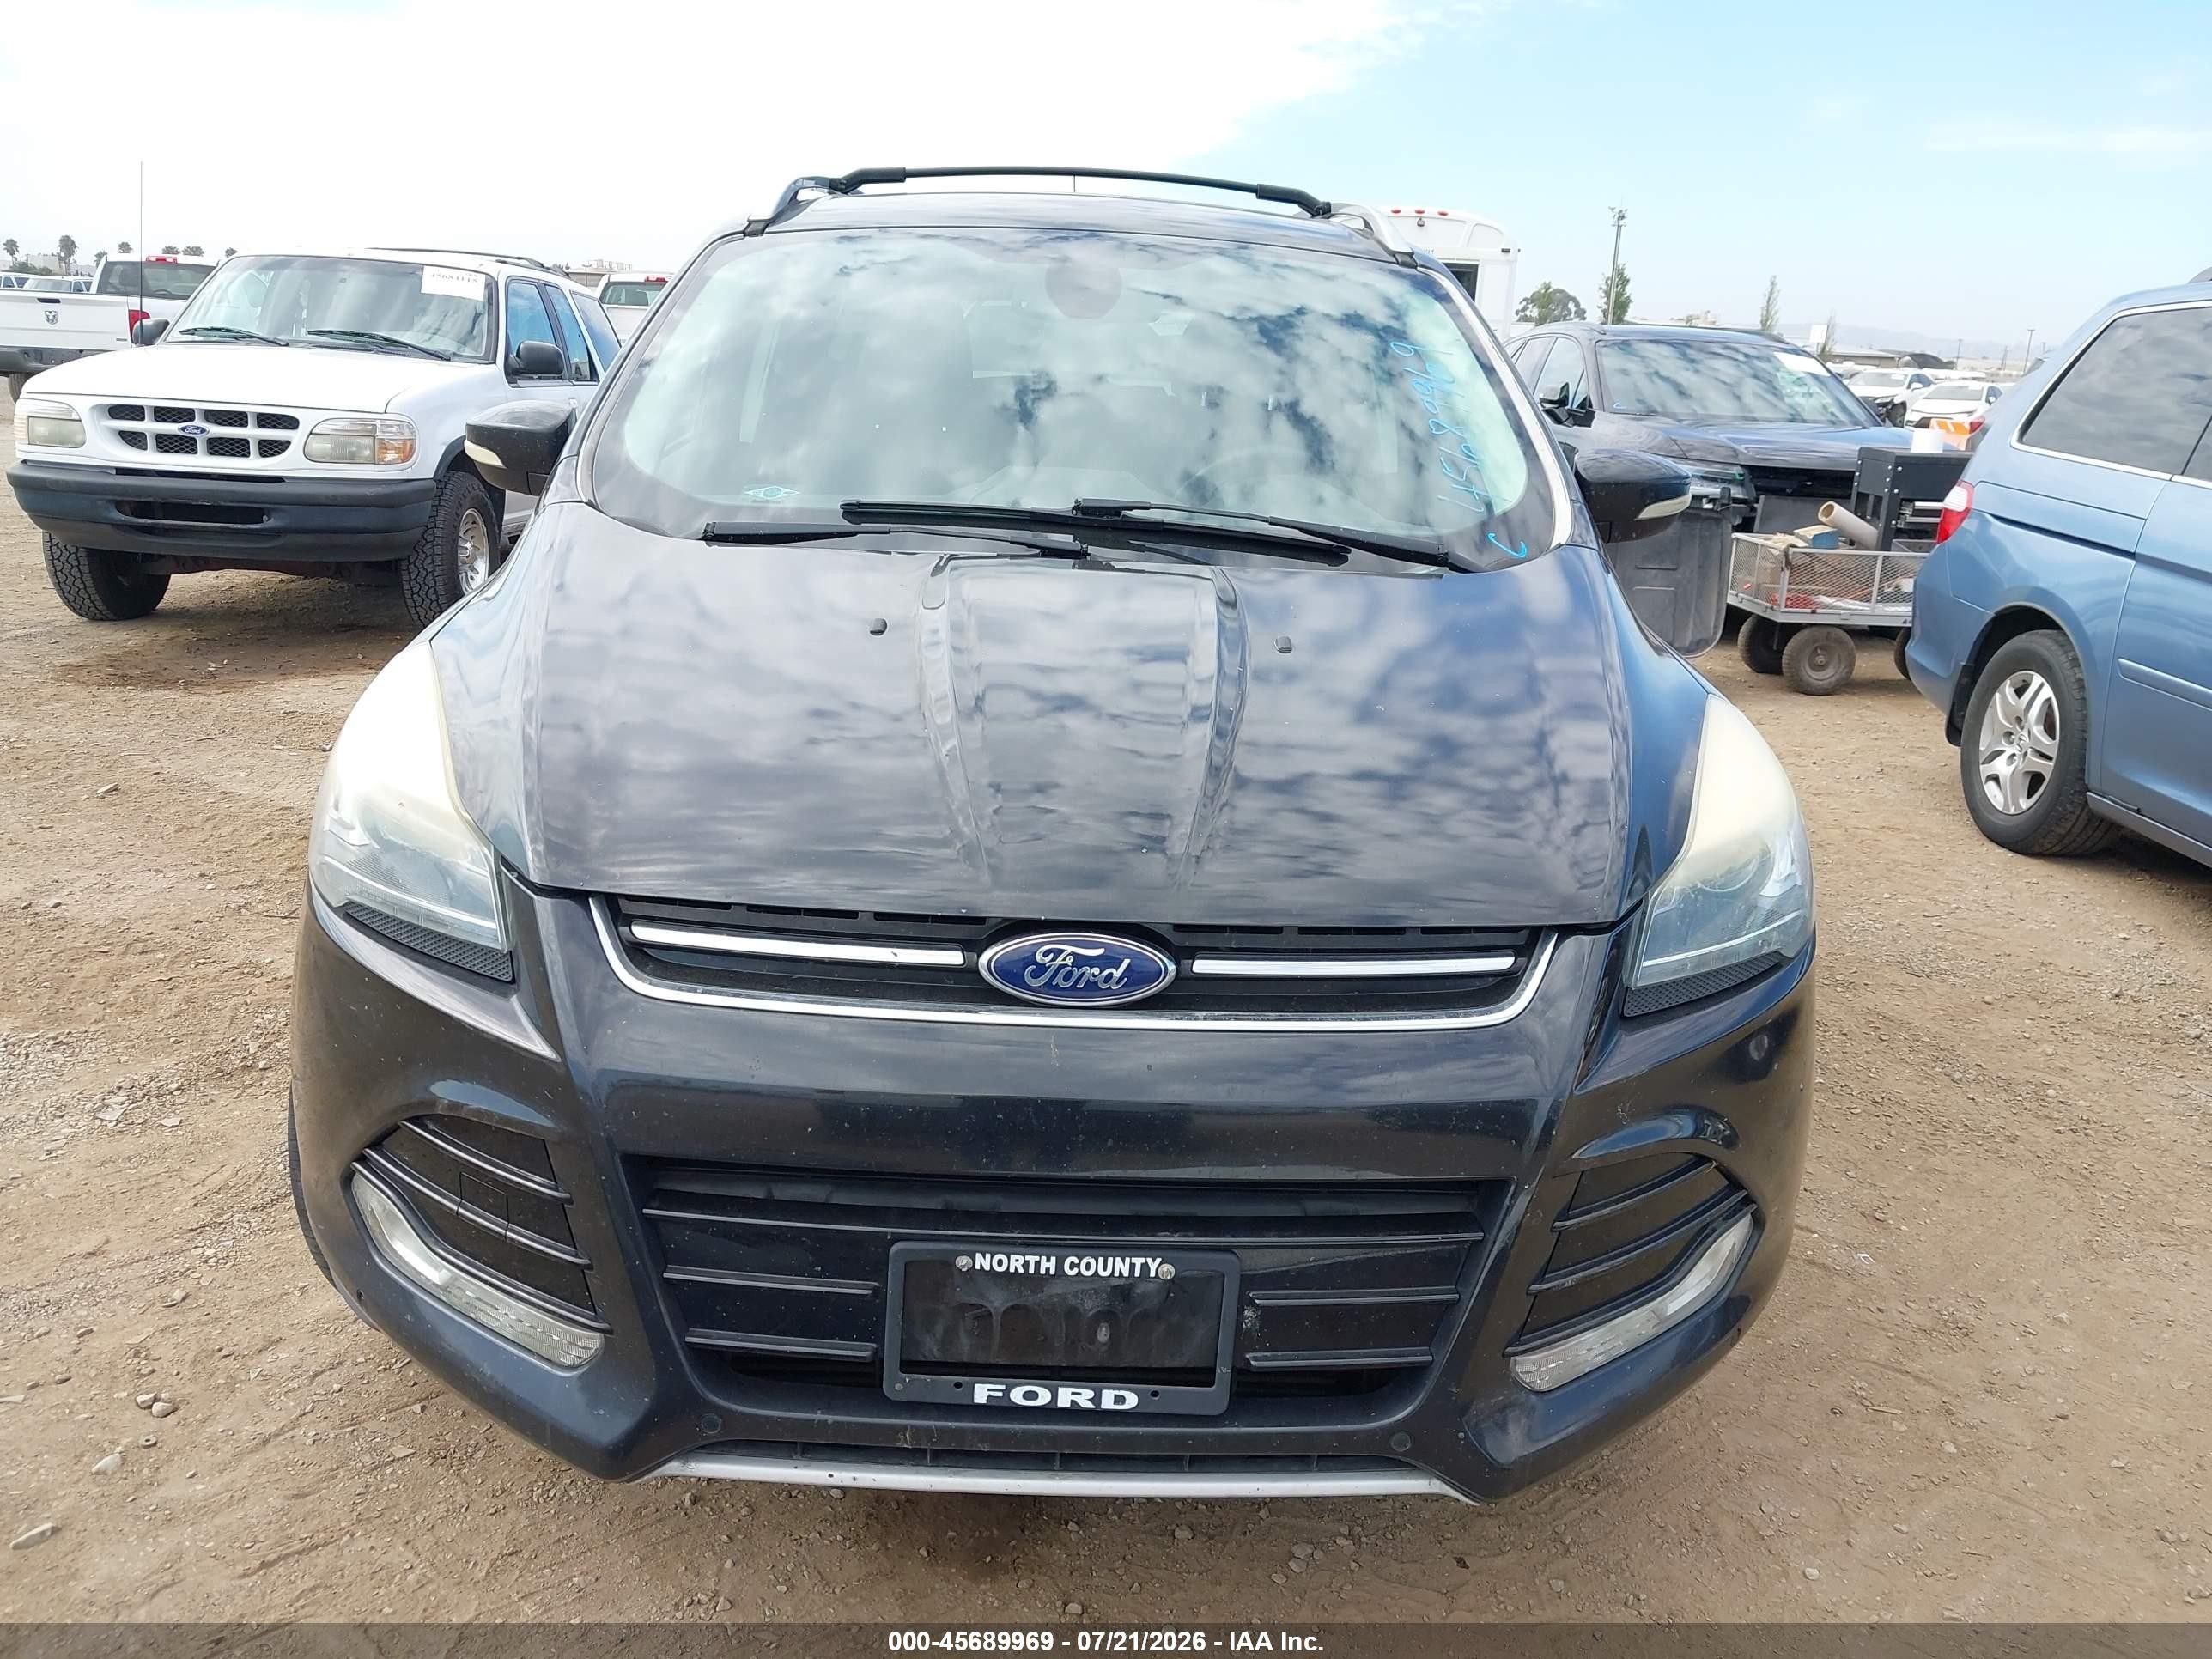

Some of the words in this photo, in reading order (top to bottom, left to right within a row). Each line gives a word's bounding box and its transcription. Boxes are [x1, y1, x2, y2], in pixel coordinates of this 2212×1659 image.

[1390, 342, 1513, 512] 45689969
[1024, 944, 1131, 990] Ford
[975, 1253, 1056, 1275] NORTH
[1064, 1256, 1162, 1278] COUNTY
[973, 1383, 1139, 1410] FORD
